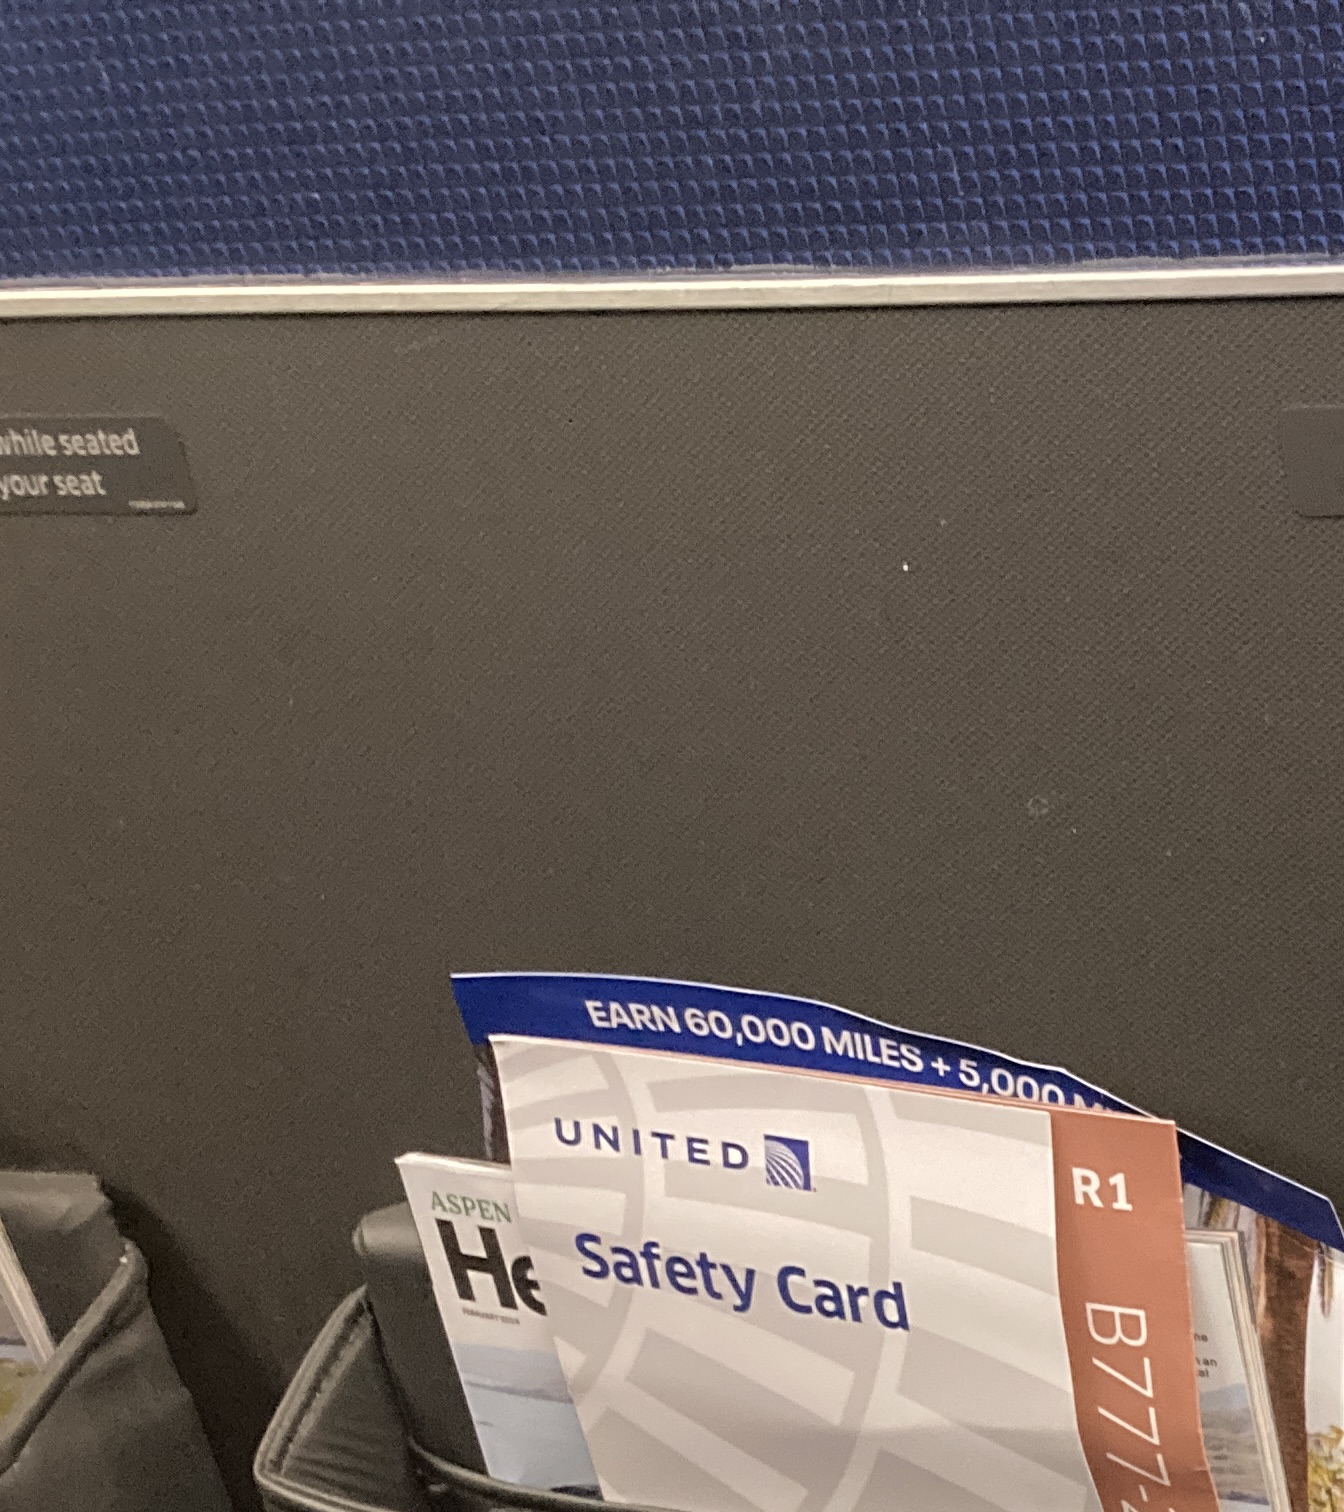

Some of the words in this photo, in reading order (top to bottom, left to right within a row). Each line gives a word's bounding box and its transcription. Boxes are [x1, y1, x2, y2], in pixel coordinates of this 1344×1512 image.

[58, 427, 140, 456] seated
[52, 470, 107, 496] seat
[584, 999, 682, 1034] EARN
[683, 1007, 815, 1051] 60,000
[821, 1026, 925, 1073] MILES
[958, 1057, 1066, 1109] 5,000
[554, 1117, 751, 1171] UNITED
[431, 1190, 512, 1224] ASPEN
[1071, 1166, 1134, 1212] R1
[574, 1232, 756, 1313] Safety
[776, 1265, 911, 1333] Card
